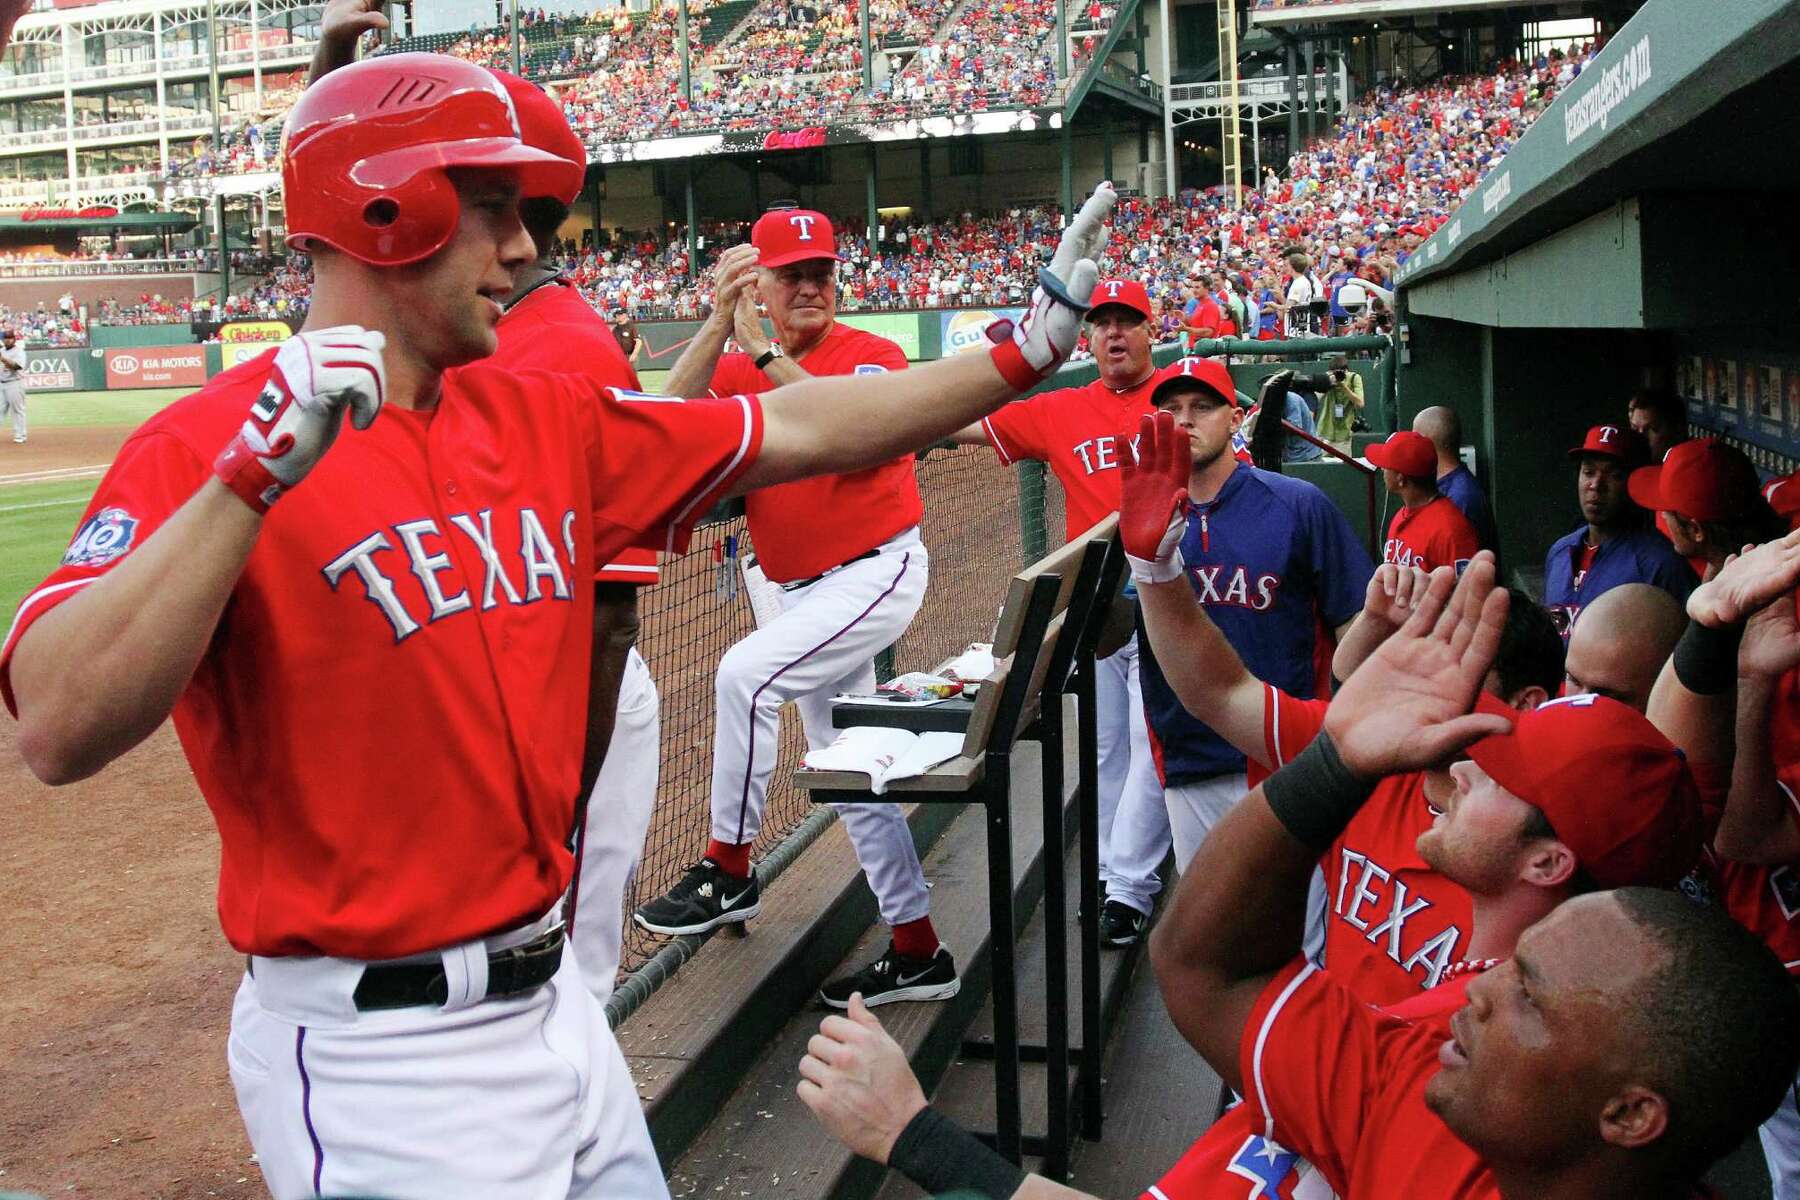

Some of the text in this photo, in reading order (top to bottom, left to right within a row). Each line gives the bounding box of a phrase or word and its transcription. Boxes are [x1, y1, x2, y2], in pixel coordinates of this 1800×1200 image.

[1564, 34, 1652, 145] texasrangers.com
[790, 215, 815, 240] T
[1104, 280, 1124, 298] T
[114, 359, 135, 372] KIA
[143, 356, 202, 369] KIA MOTORS
[1177, 357, 1199, 376] T
[26, 375, 71, 386] NCE
[1600, 425, 1618, 444] T
[1072, 433, 1141, 476] TEX
[1195, 566, 1279, 612] XAS
[1333, 847, 1462, 992] TEXA
